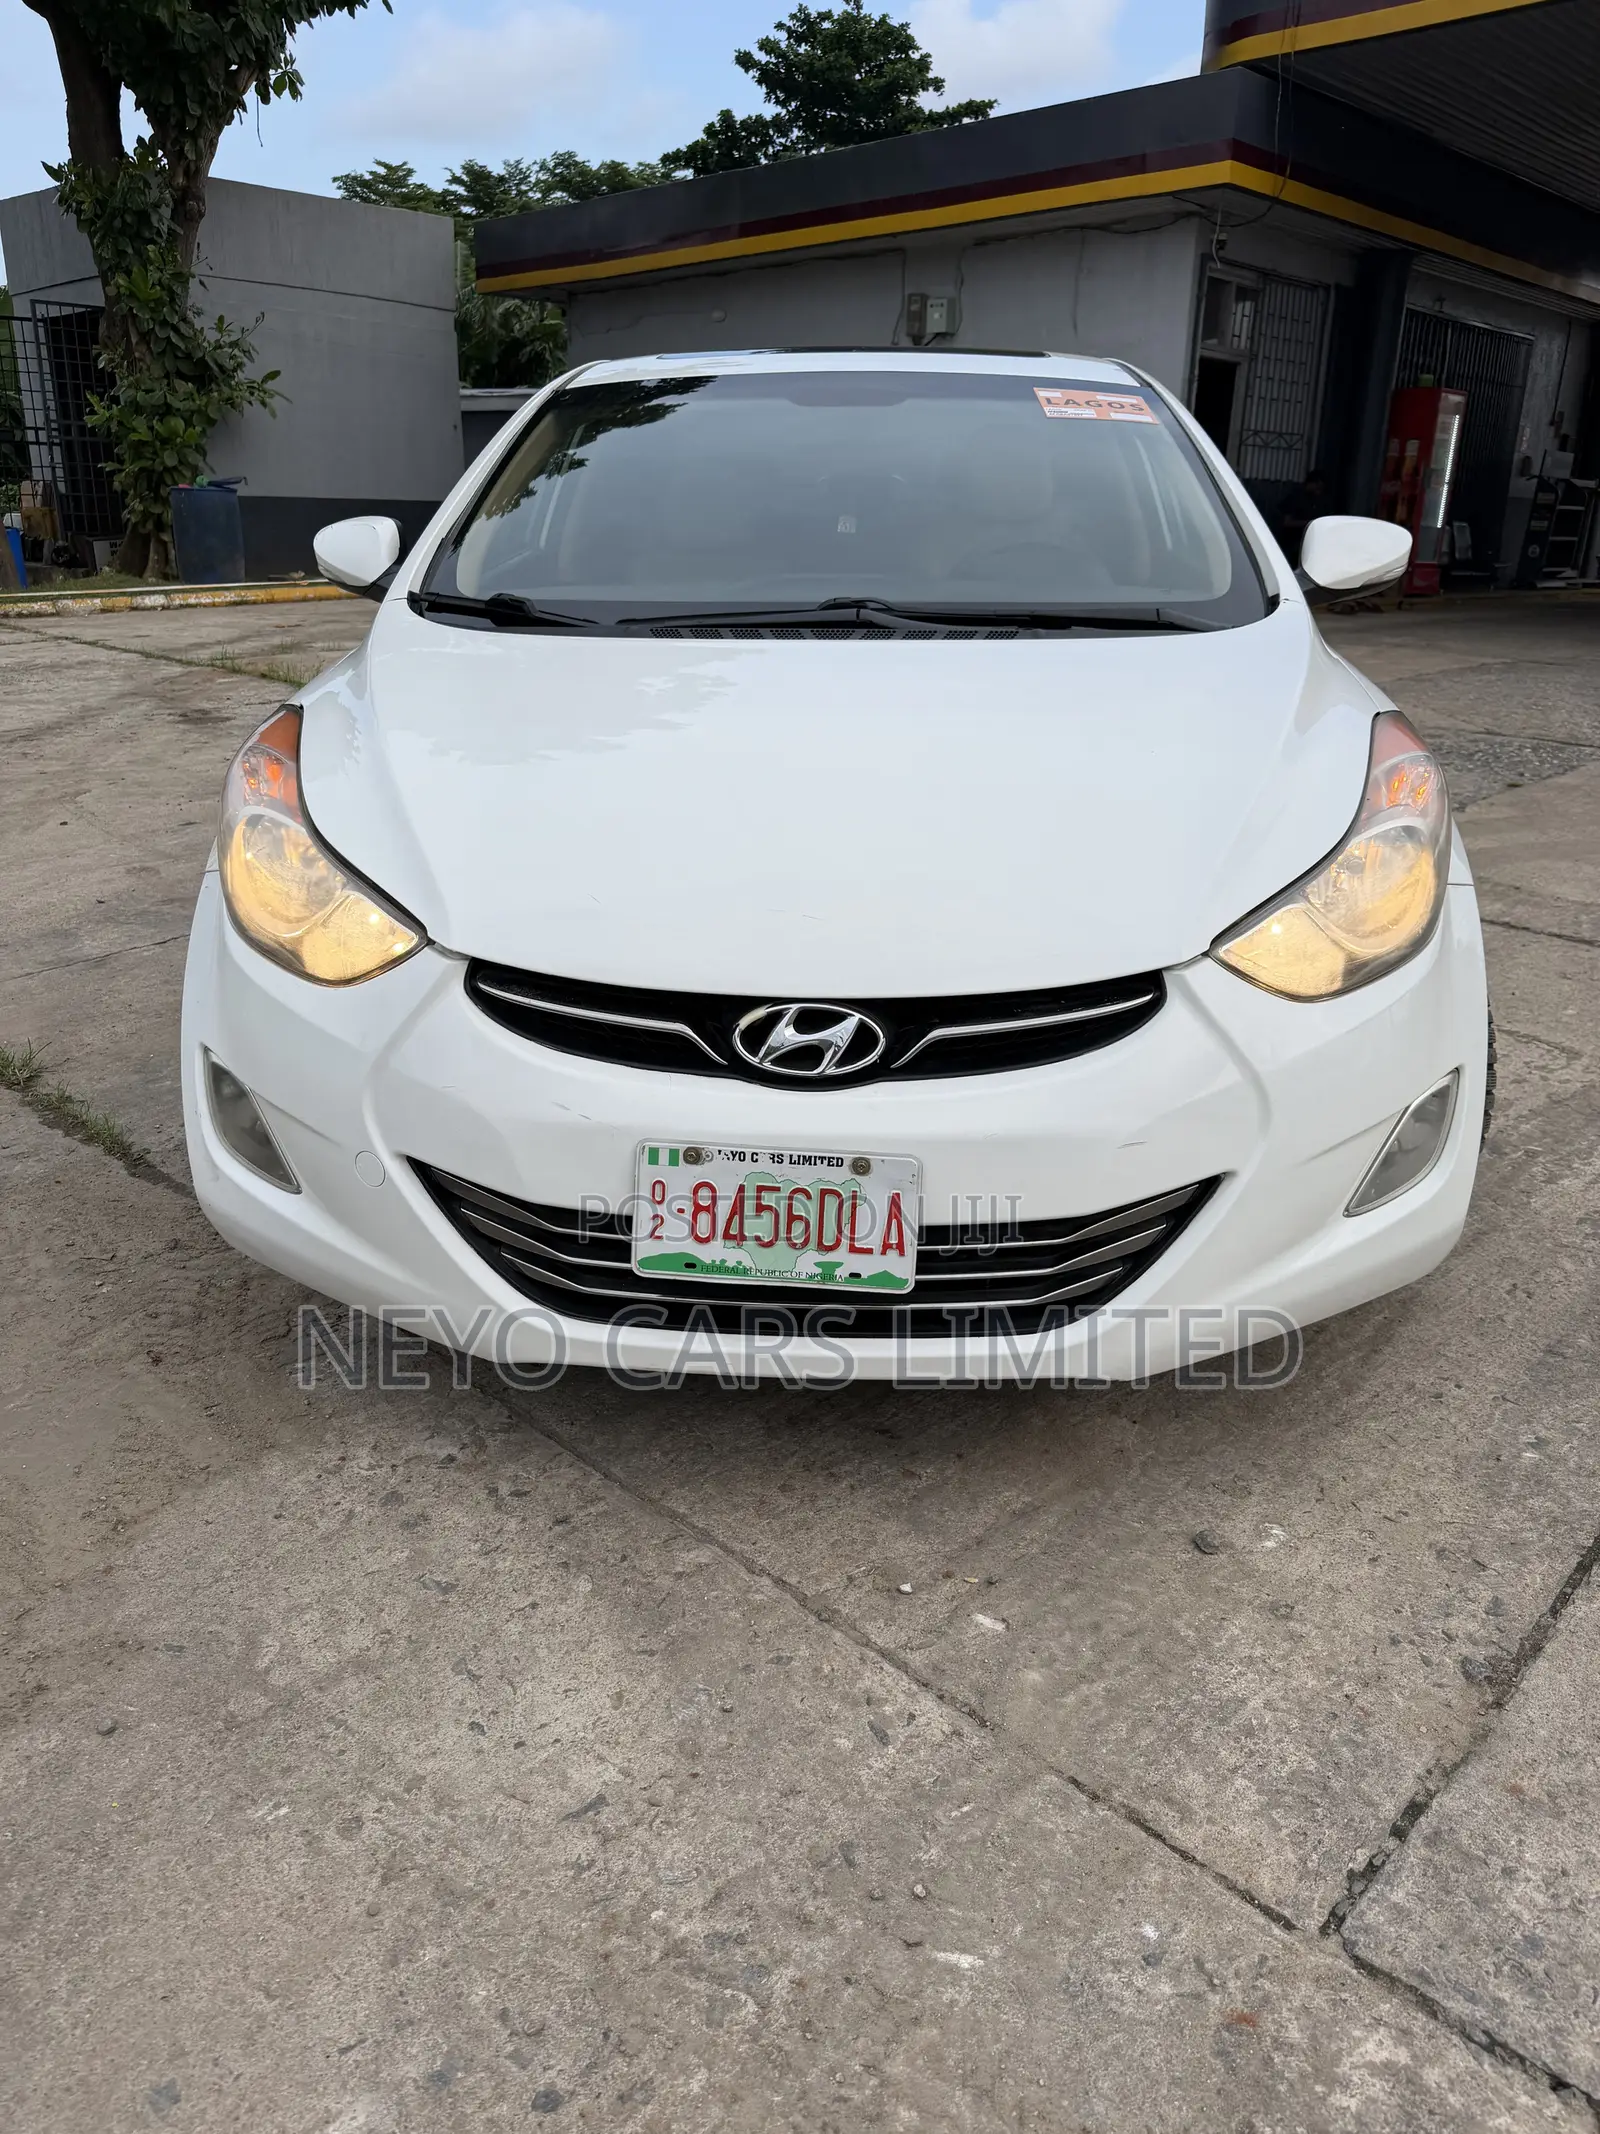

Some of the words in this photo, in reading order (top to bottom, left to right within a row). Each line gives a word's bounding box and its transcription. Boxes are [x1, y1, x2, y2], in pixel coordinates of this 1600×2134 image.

[1044, 397, 1145, 412] LAGOS
[750, 1151, 784, 1165] CRS
[788, 1153, 844, 1168] LIMITED
[700, 1264, 742, 1275] FEDERAL
[743, 1267, 789, 1278] REPUBLIC
[790, 1270, 804, 1279] OF
[805, 1272, 845, 1282] NIGERIA
